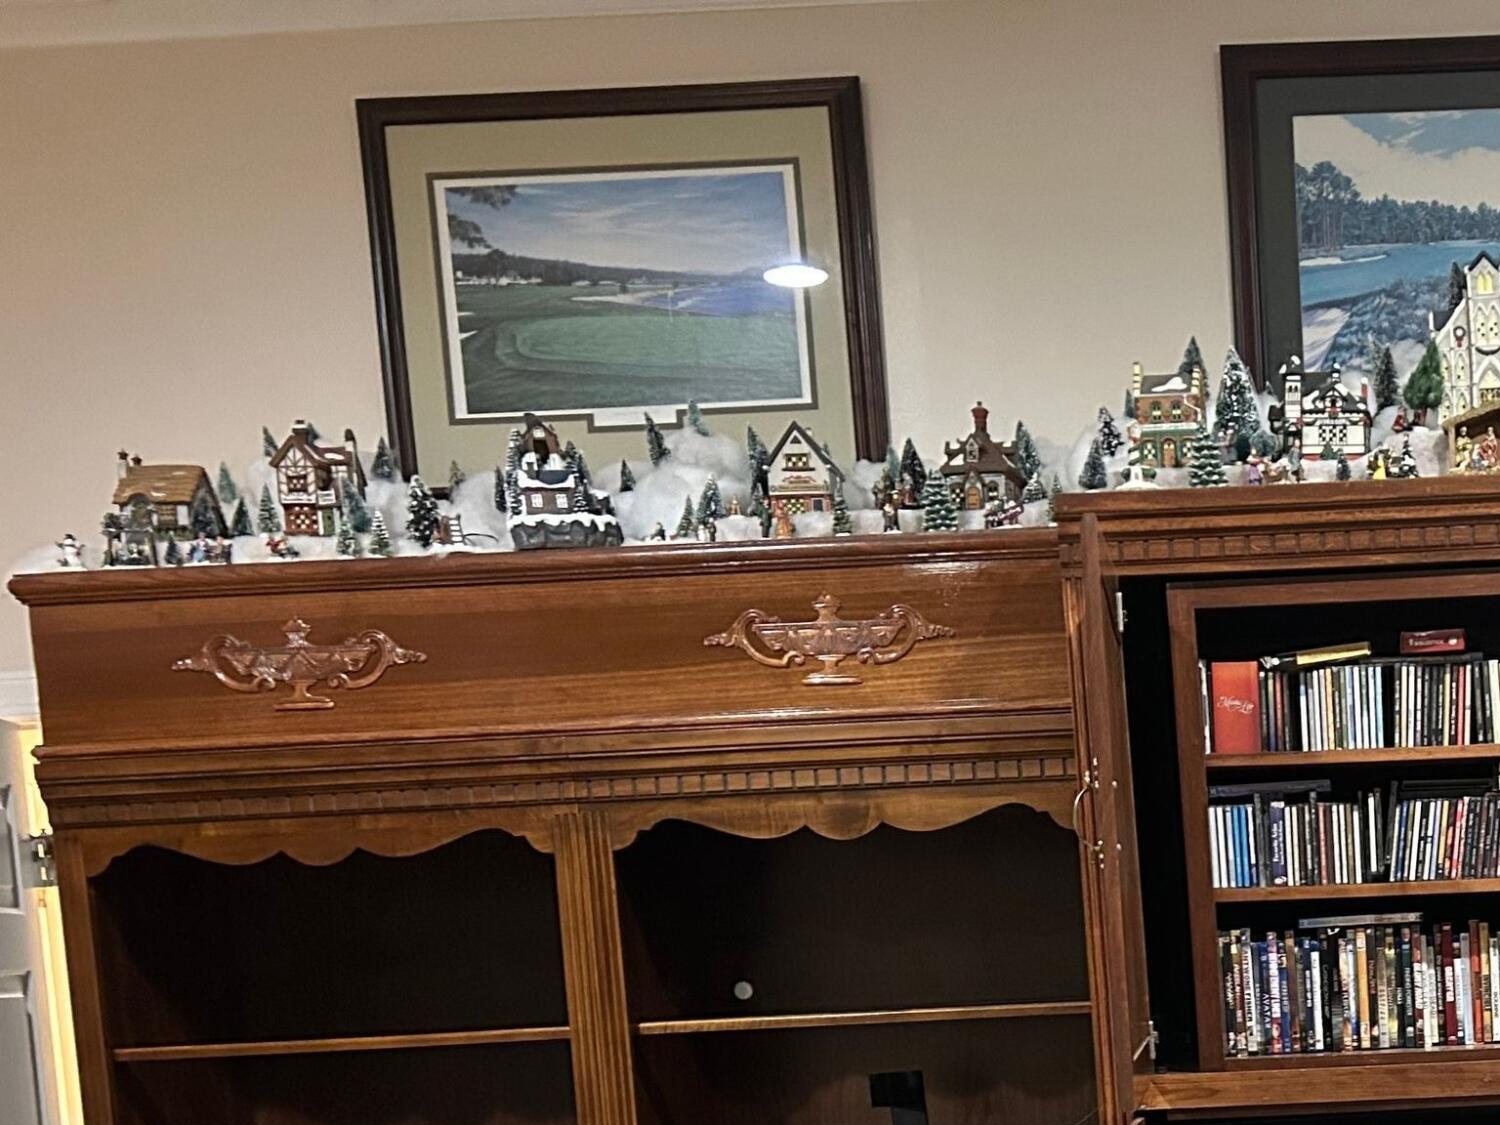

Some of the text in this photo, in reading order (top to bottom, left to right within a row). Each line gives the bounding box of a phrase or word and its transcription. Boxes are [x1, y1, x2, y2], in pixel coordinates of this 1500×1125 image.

[1242, 950, 1251, 991] ANTWONE
[1445, 966, 1454, 1002] GREATER
[1262, 993, 1271, 1029] AVATAR
